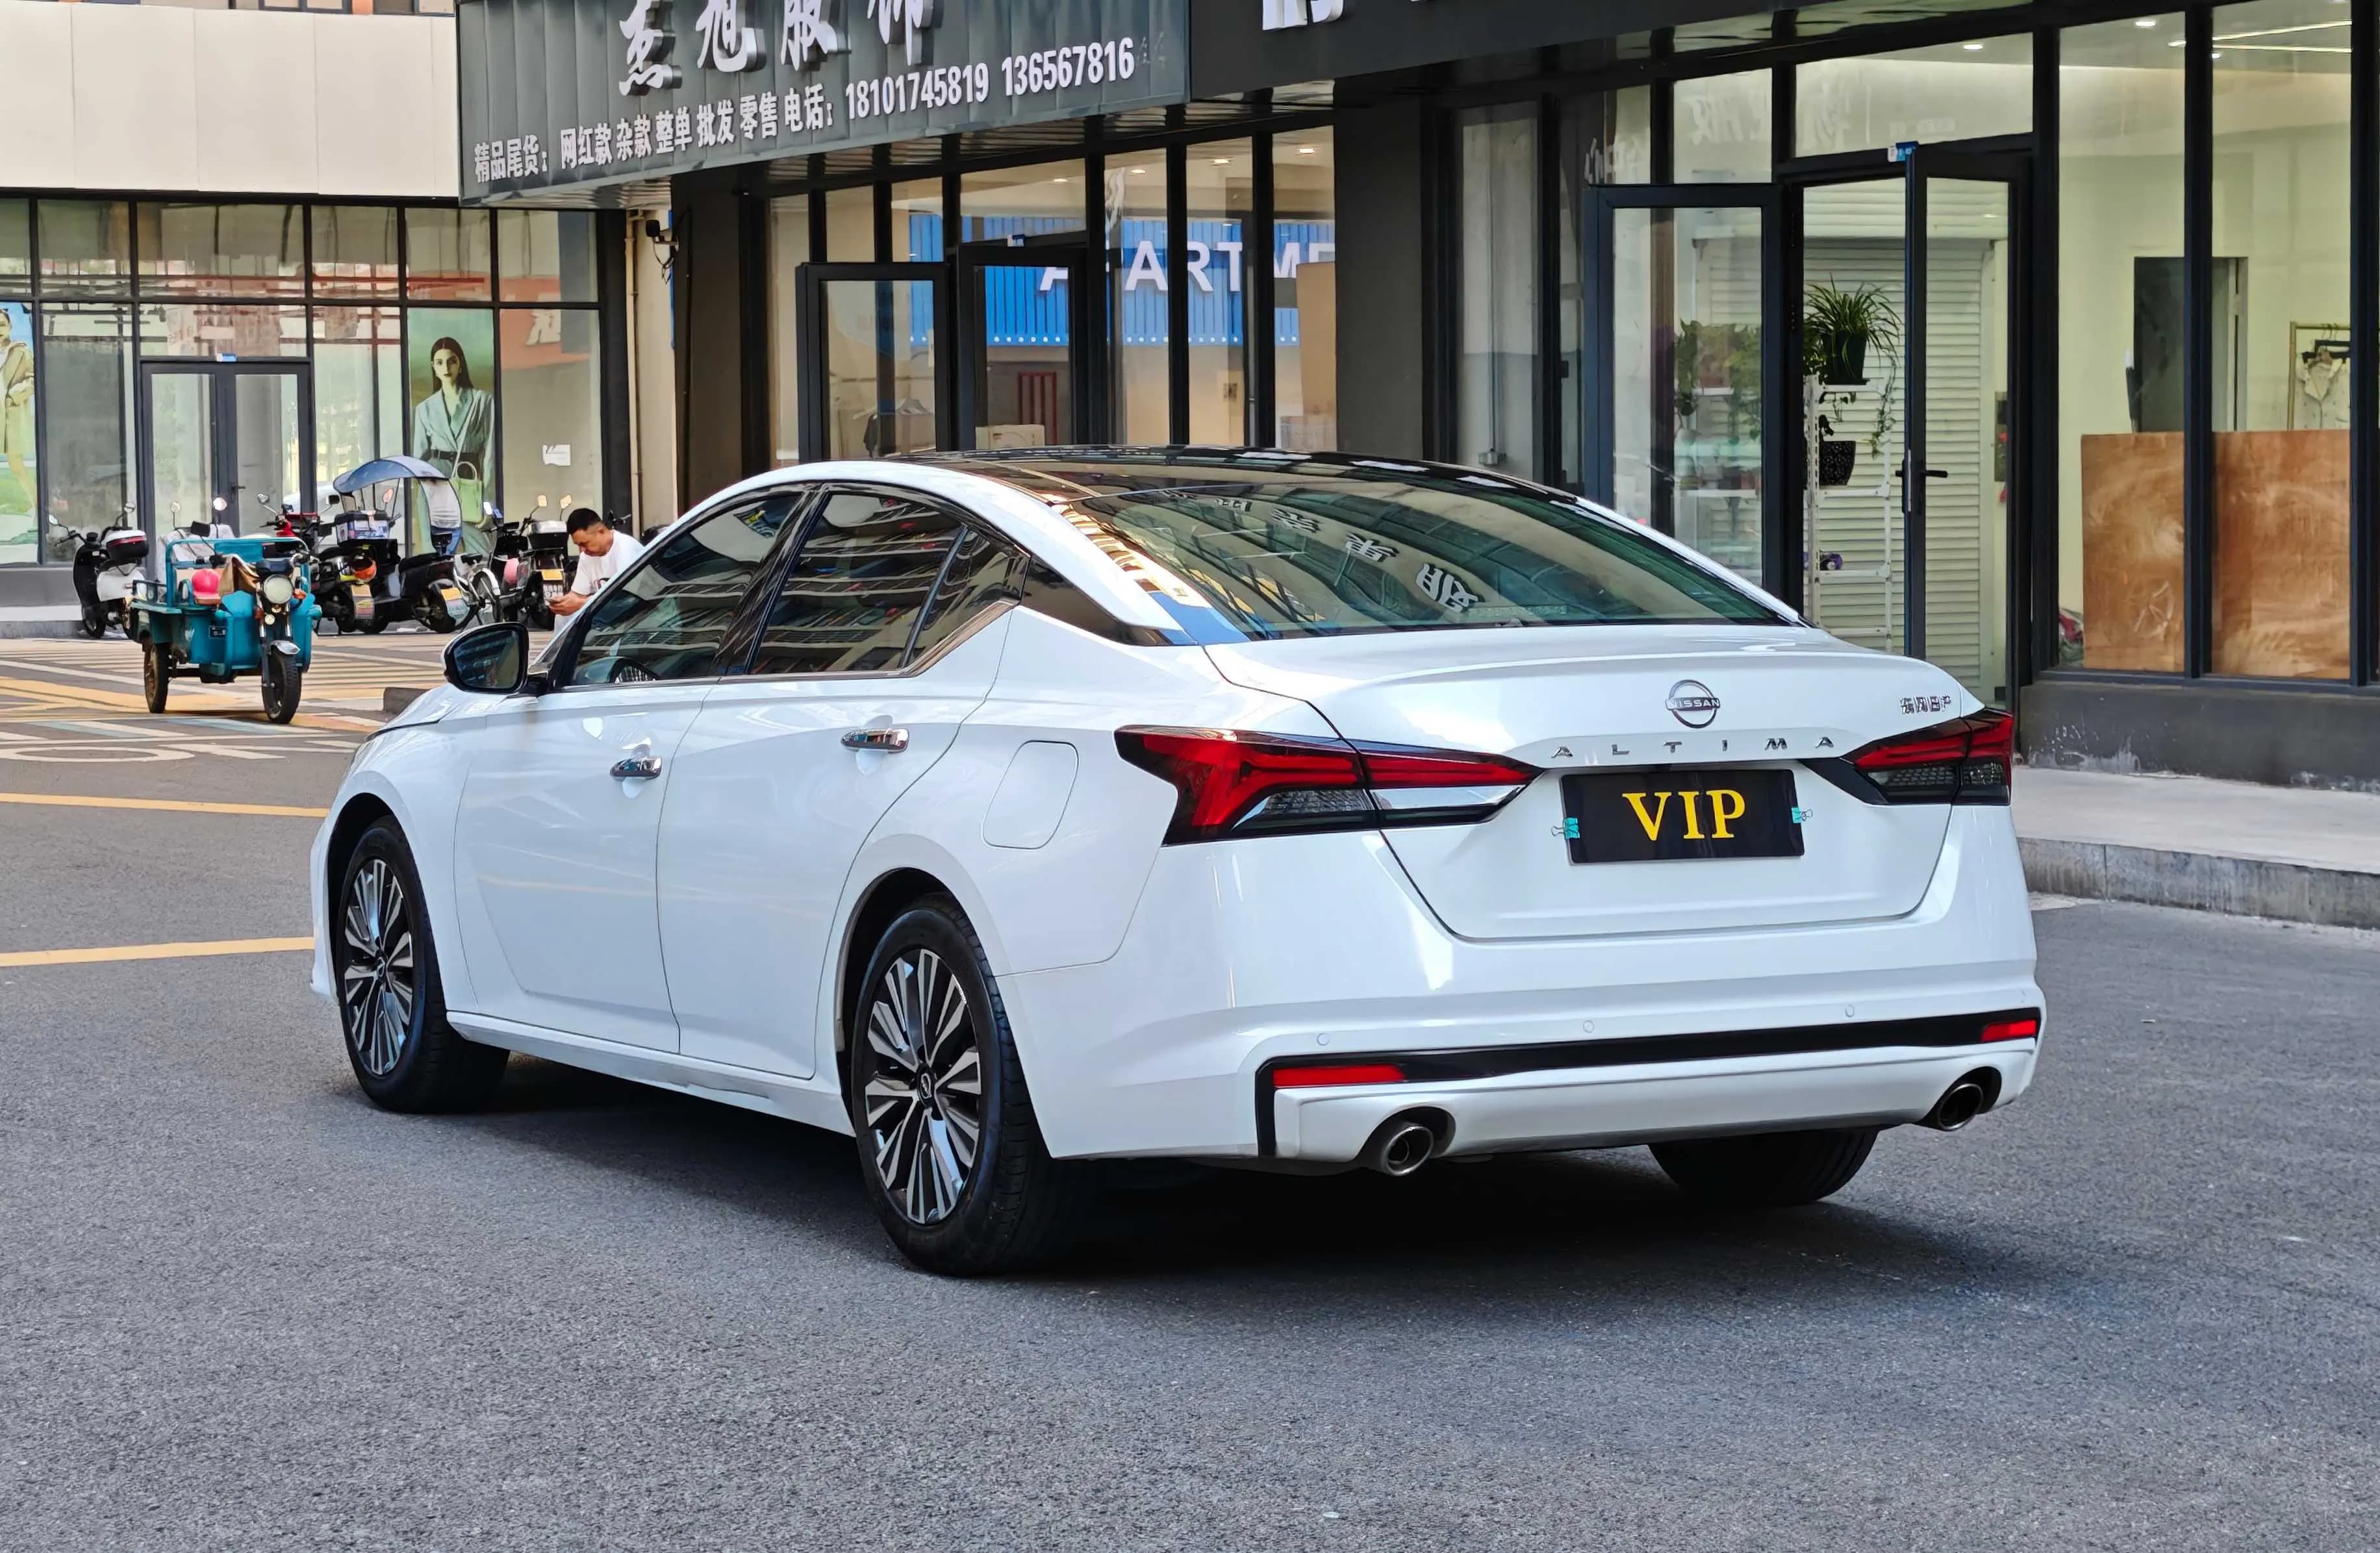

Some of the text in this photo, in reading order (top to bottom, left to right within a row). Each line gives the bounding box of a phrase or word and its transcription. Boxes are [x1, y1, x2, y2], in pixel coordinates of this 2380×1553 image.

[560, 122, 613, 170] 网红款
[616, 114, 652, 161] 杂款
[655, 106, 692, 154] 整单
[696, 99, 735, 147] 批发
[739, 91, 778, 140] 零售
[846, 62, 989, 120] 18101745819
[1002, 37, 1135, 96] 136567816
[1667, 699, 1719, 708] NISSAN
[1551, 737, 1835, 759] ALTIMA
[1623, 789, 1745, 840] VIP
